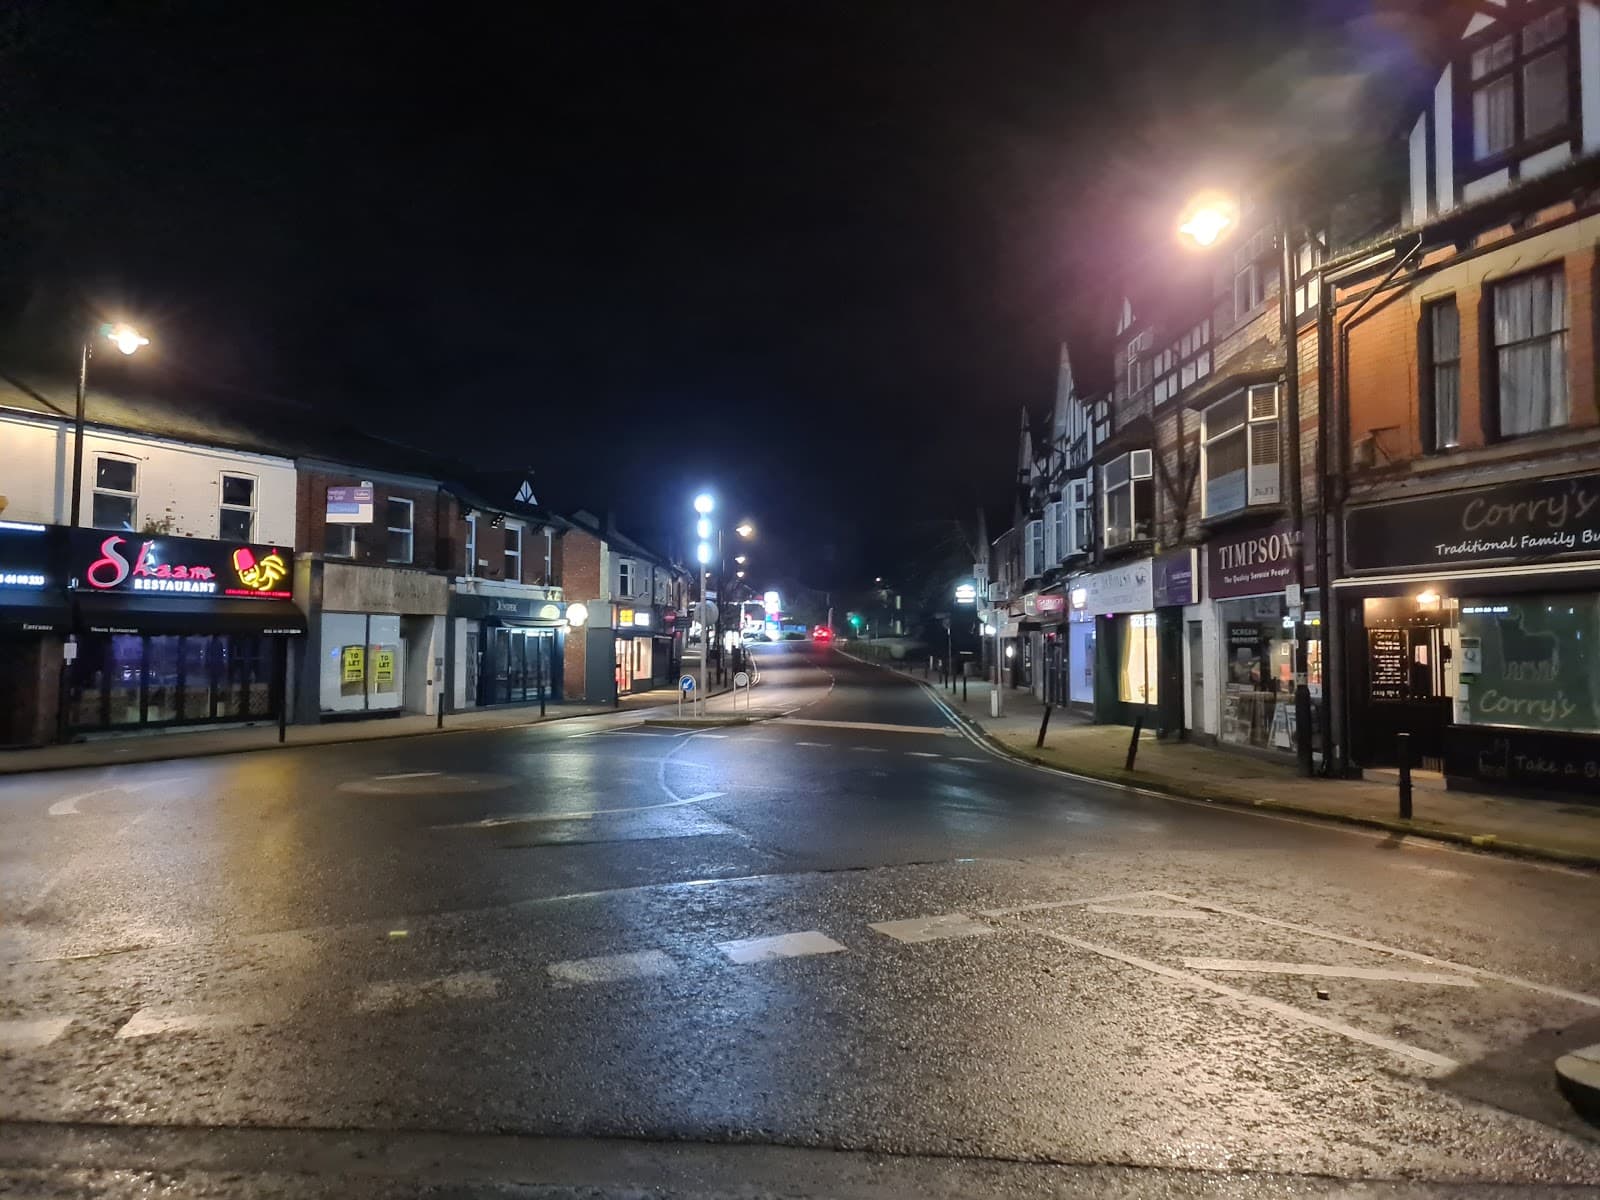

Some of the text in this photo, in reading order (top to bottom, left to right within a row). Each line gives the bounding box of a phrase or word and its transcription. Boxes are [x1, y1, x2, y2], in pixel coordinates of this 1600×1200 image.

[1462, 479, 1600, 531] Corry's
[1218, 531, 1303, 570] TIMPSON
[1435, 536, 1518, 556] Traditional
[1521, 531, 1576, 548] Family
[134, 578, 216, 592] RESTAURANT
[1479, 688, 1577, 722] Corry's
[1513, 755, 1558, 773] Take
